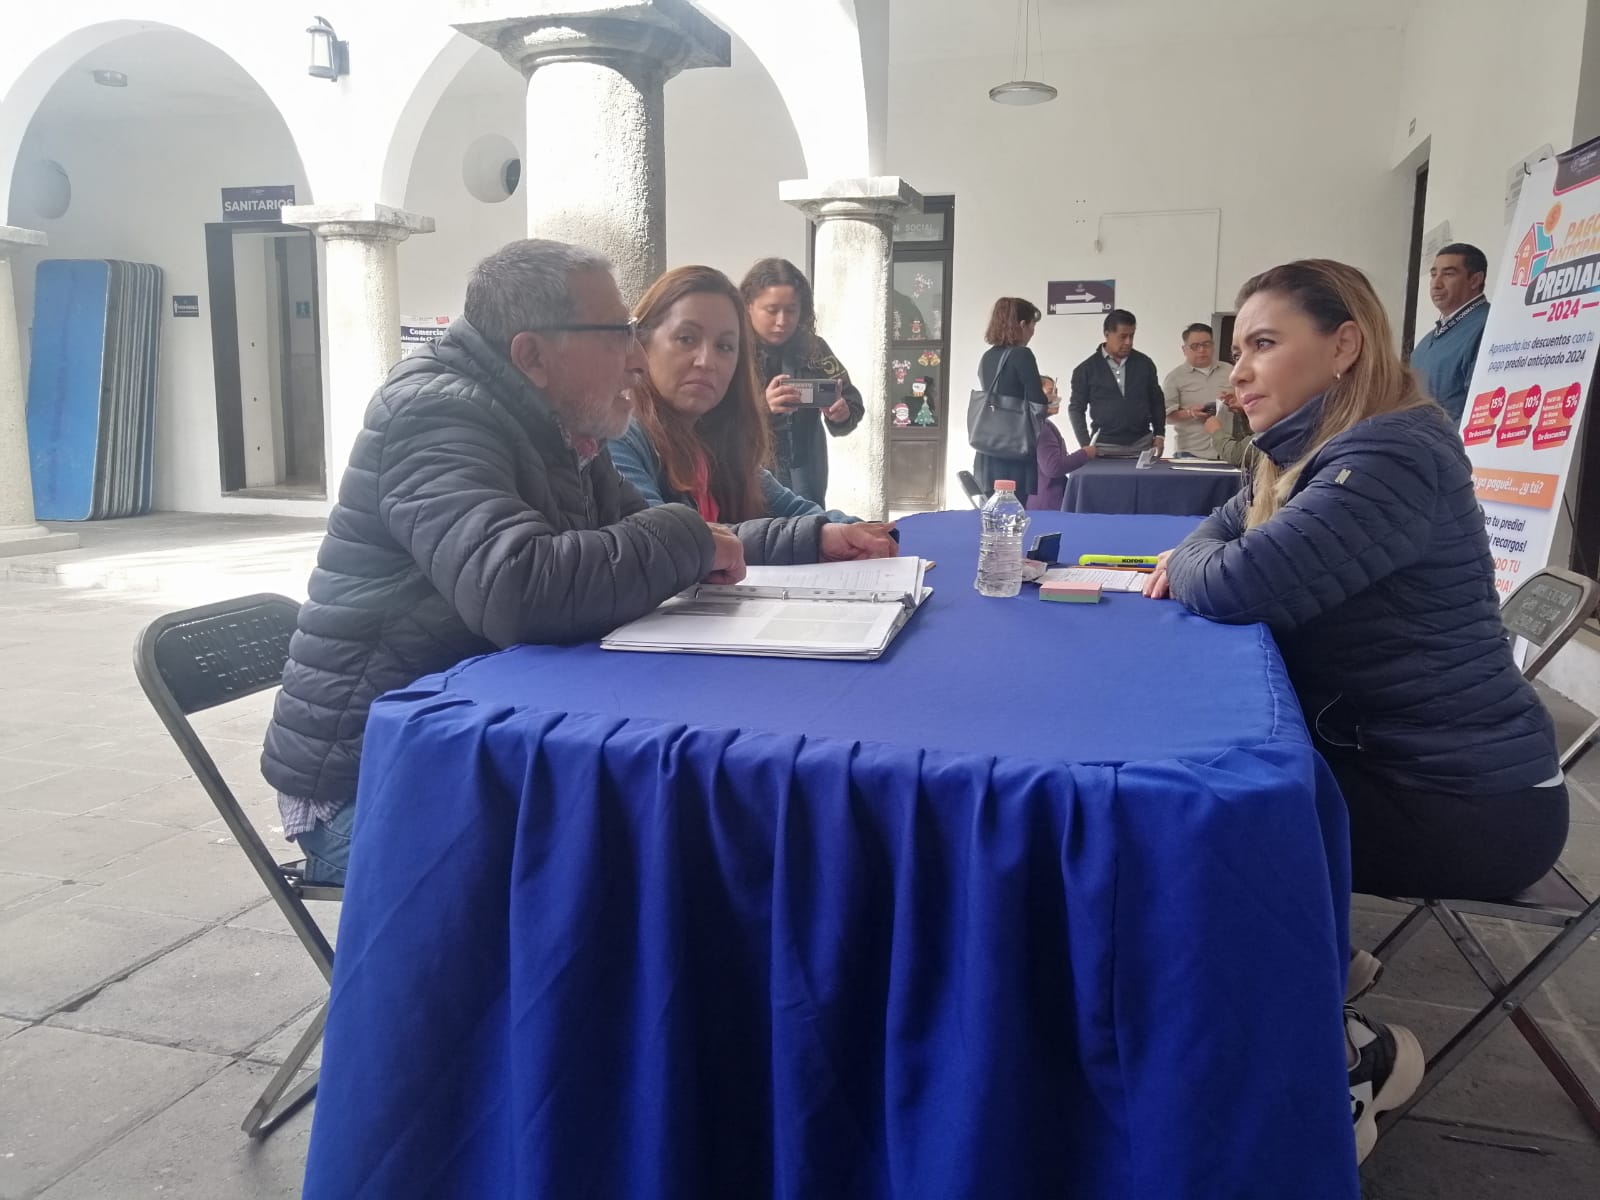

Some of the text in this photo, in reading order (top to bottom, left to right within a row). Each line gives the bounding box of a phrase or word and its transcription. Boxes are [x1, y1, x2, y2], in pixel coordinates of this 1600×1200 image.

[224, 199, 293, 212] SANITARIOS
[1531, 261, 1600, 303] PREDIAL
[1547, 298, 1581, 322] 2024
[1531, 334, 1572, 349] descuentos
[1571, 333, 1586, 345] con
[1504, 355, 1528, 371] predial
[1527, 352, 1565, 368] anticipado
[1564, 349, 1587, 364] 2024
[1490, 395, 1504, 409] 15%
[1524, 394, 1539, 409] 10%
[1565, 394, 1579, 409] 5%
[1492, 515, 1500, 527] tu
[1499, 519, 1526, 532] predial
[1492, 535, 1528, 553] recargos!
[1509, 559, 1521, 573] TU
